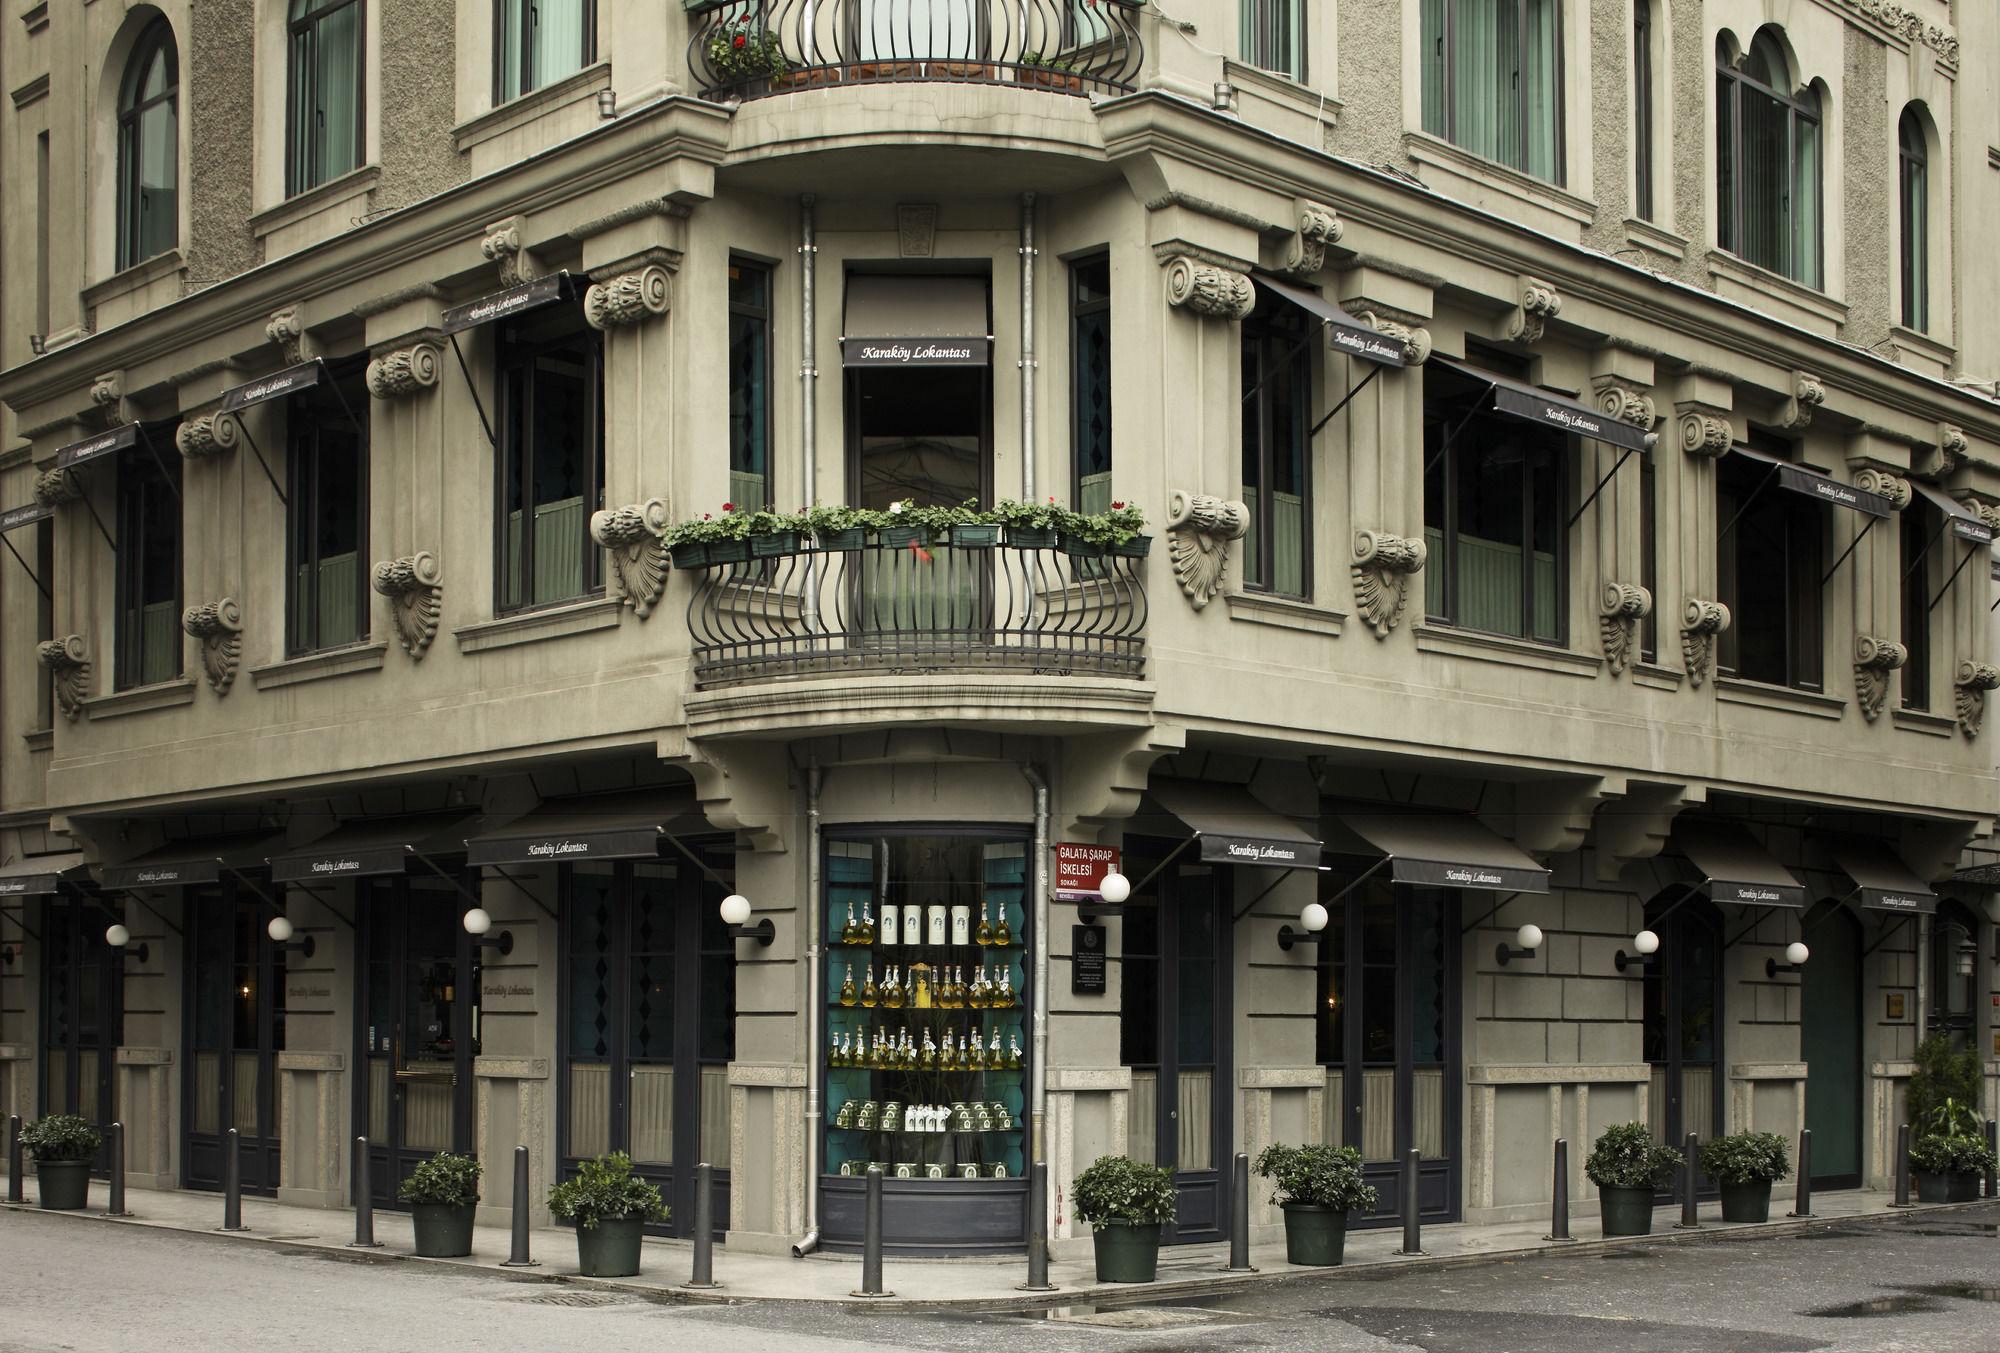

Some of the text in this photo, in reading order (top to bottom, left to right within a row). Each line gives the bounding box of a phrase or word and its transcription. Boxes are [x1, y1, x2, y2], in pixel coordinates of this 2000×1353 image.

[860, 345, 971, 362] Karaköy Lokantası
[1334, 332, 1399, 360] Karaköy Lokantası
[1545, 408, 1599, 433] Karaköy Lokantası
[527, 840, 588, 858] Karaköy Lokantası
[1060, 847, 1113, 862] GALATA ŞARAP
[1228, 844, 1296, 860] Karaköy Lokantası
[1060, 861, 1092, 876] İSKELESİ
[1060, 879, 1079, 887] SOKAĞI
[1446, 870, 1502, 884] Karaköy Lokantası
